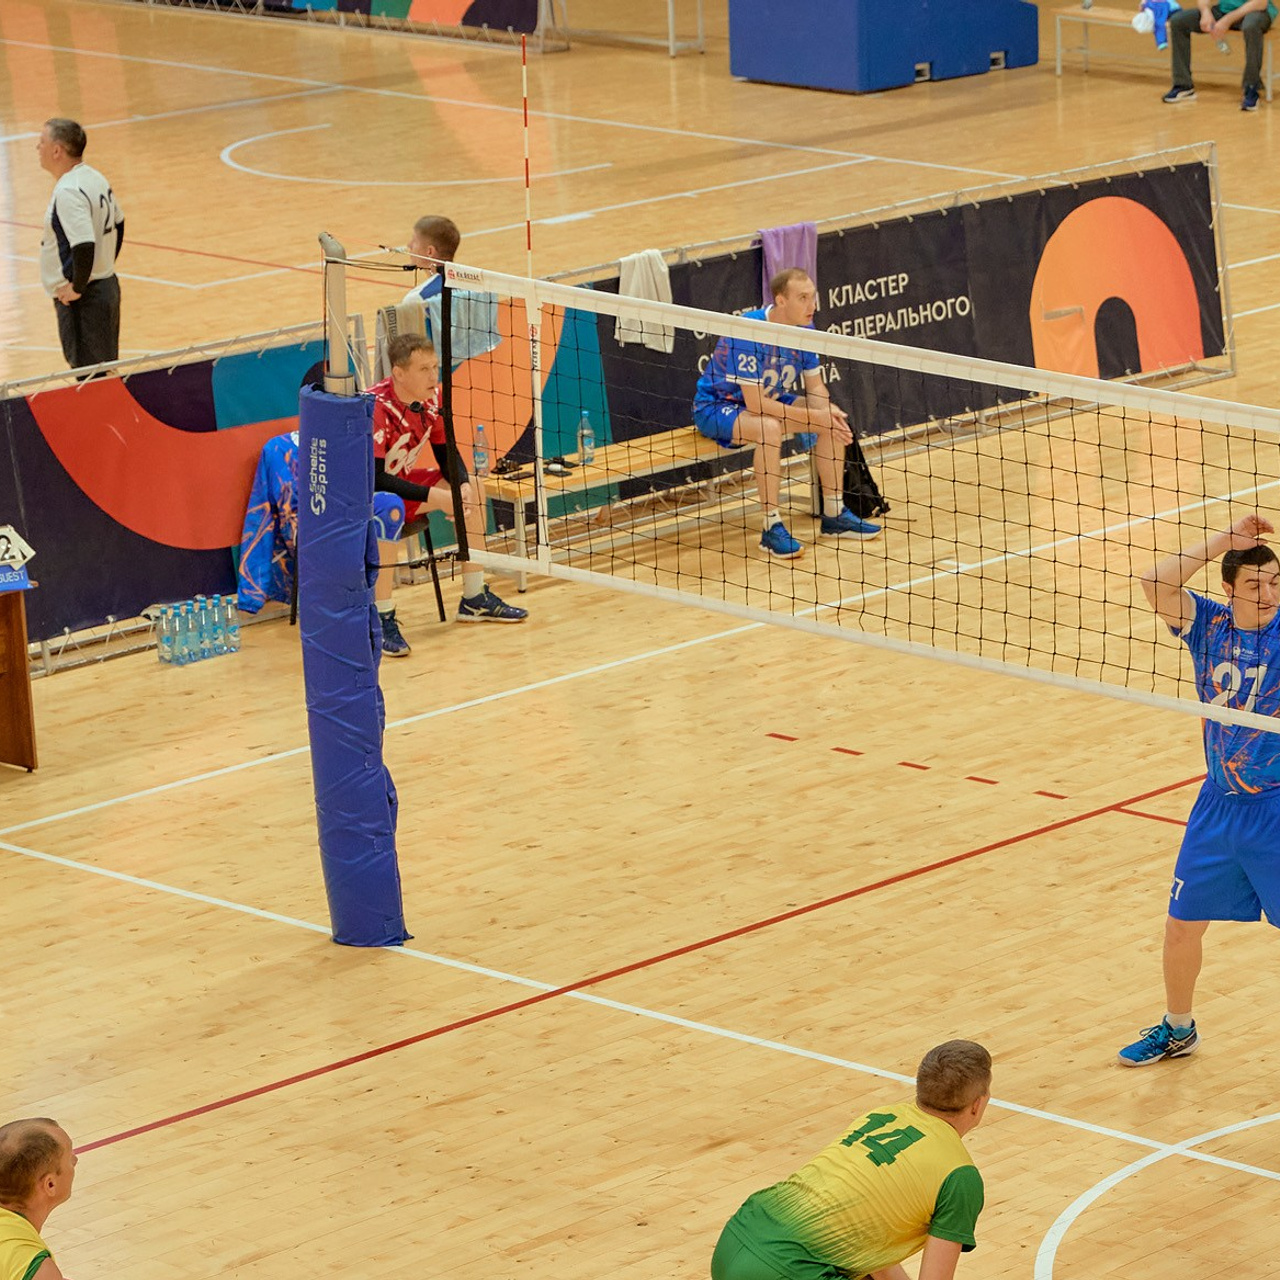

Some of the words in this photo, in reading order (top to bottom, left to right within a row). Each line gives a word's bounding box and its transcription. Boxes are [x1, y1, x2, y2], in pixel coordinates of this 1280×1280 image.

[828, 272, 909, 309] КЛАСТЕР
[738, 353, 757, 373] 23
[310, 437, 318, 492] Schelde
[318, 438, 328, 494] Sports
[1210, 661, 1268, 727] 27
[1170, 877, 1184, 900] 7
[839, 1112, 926, 1167] 14
